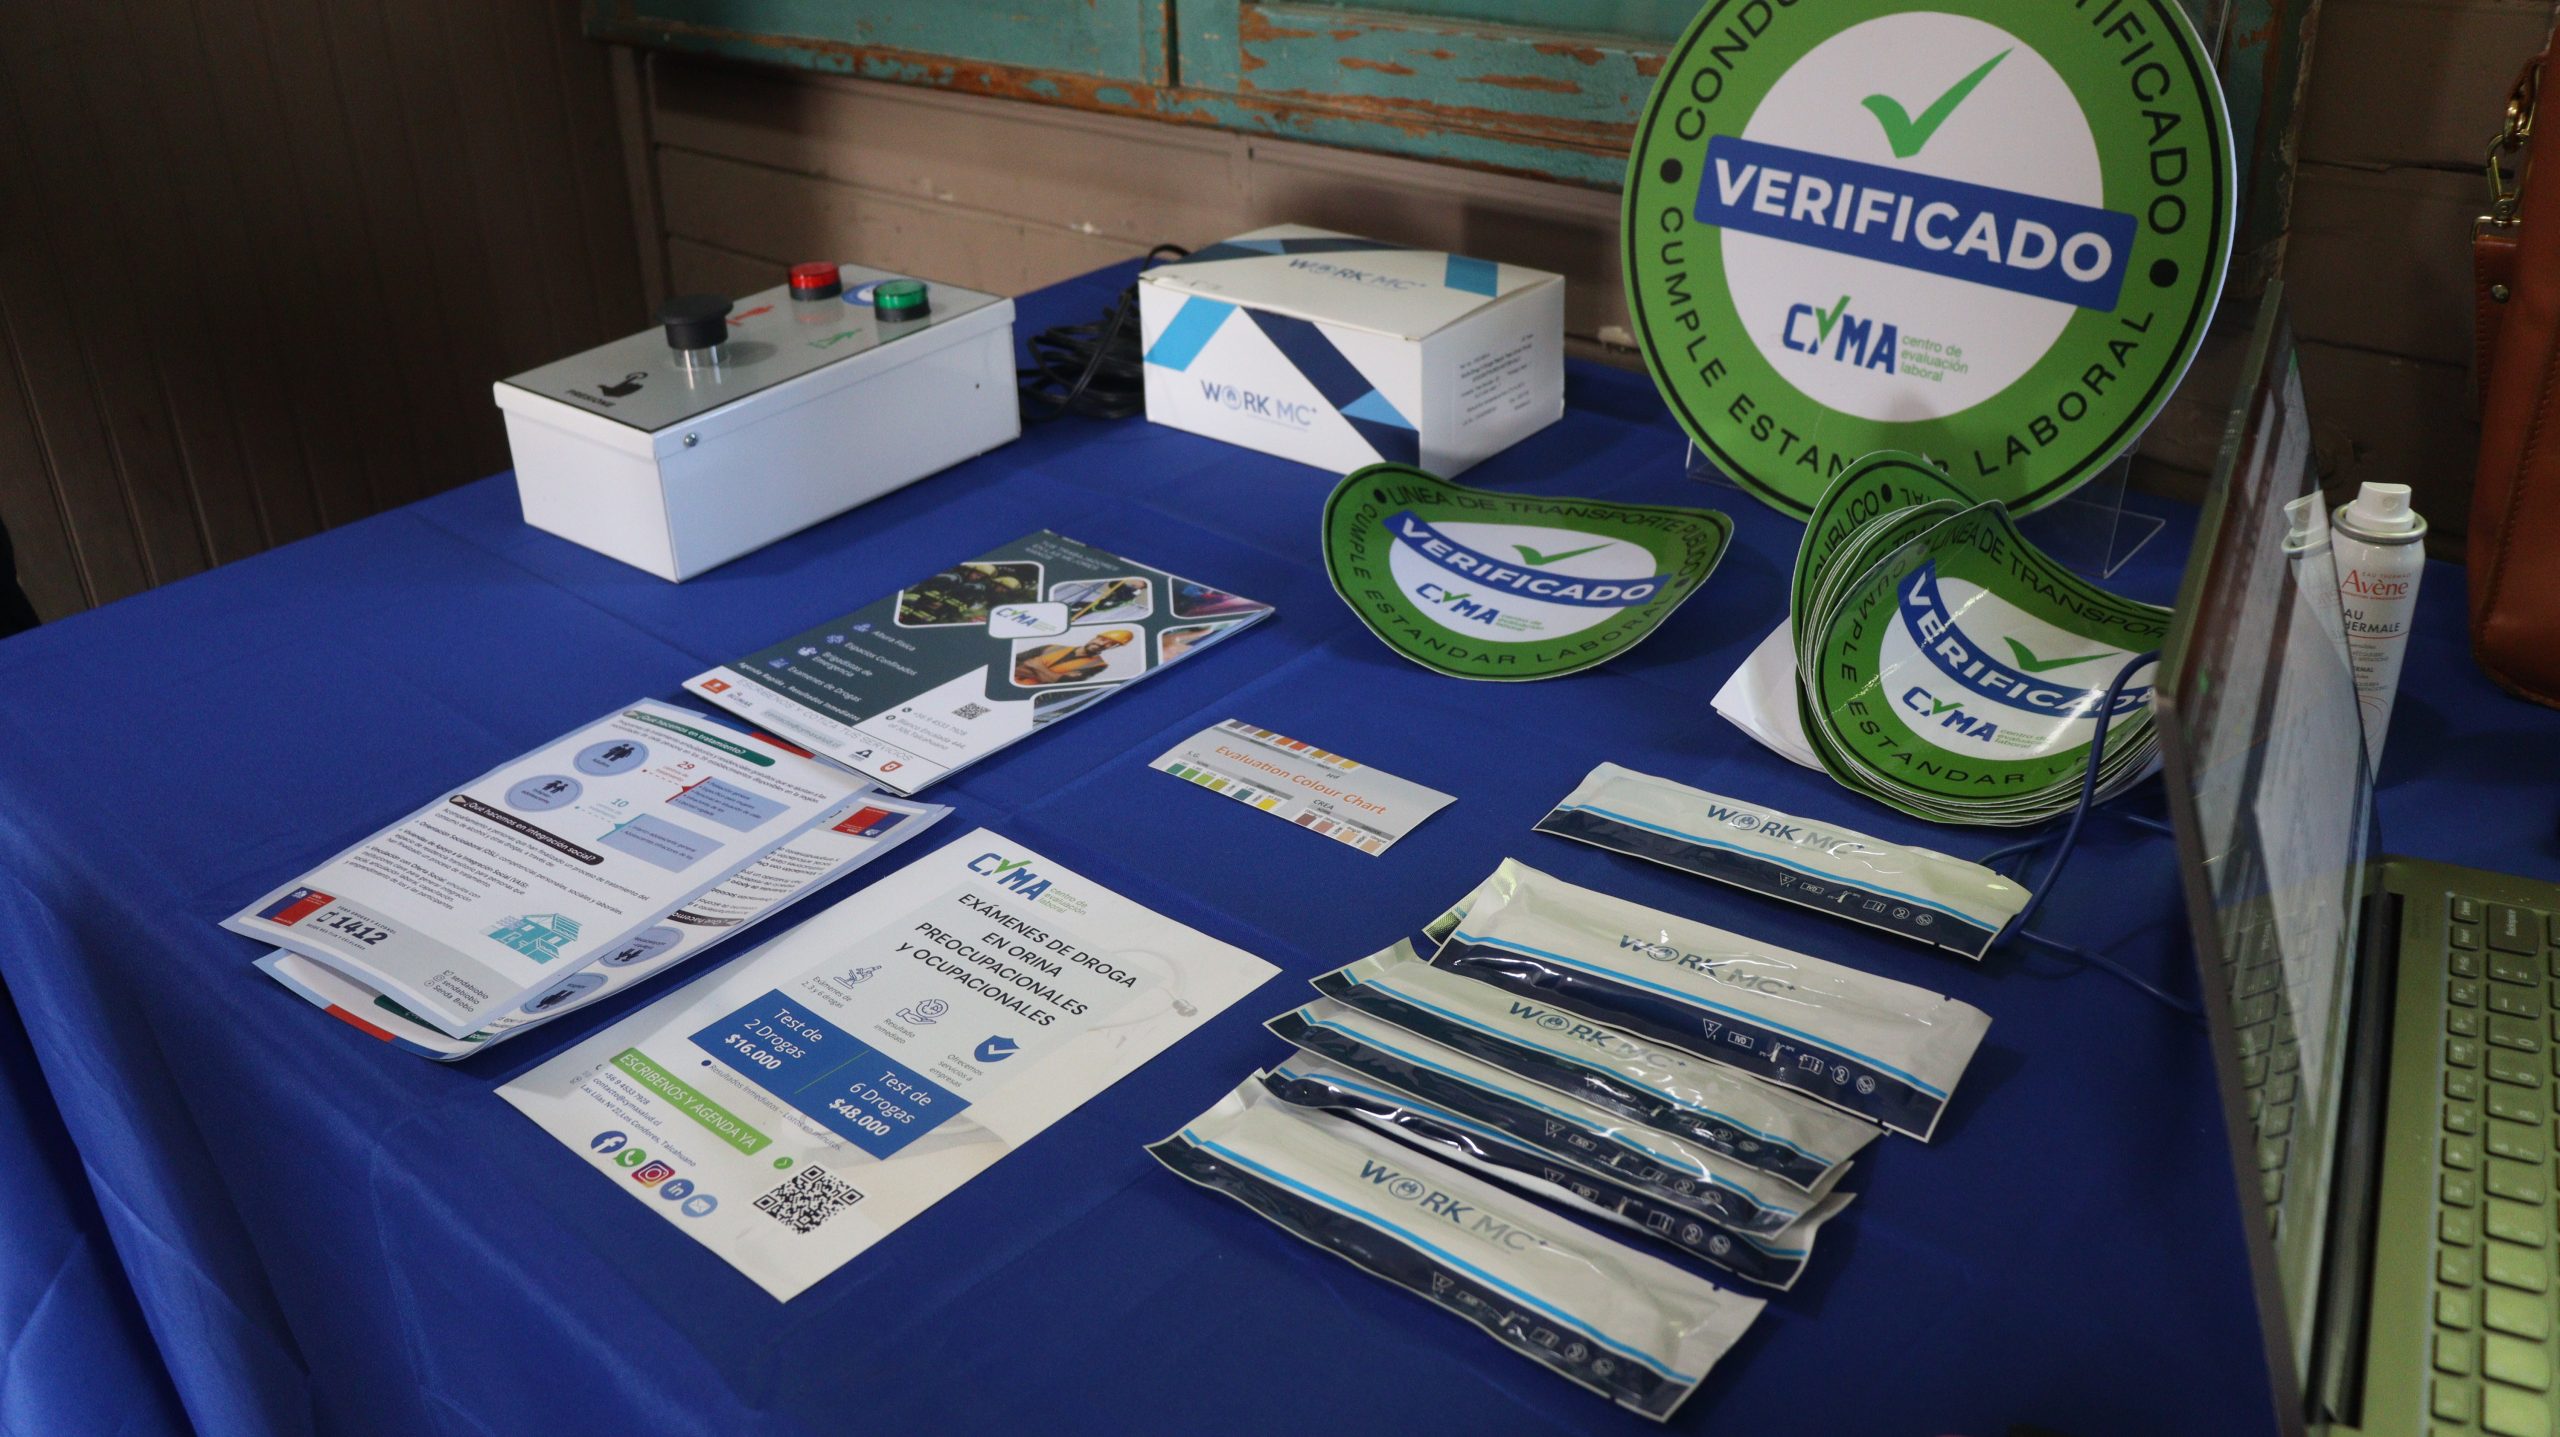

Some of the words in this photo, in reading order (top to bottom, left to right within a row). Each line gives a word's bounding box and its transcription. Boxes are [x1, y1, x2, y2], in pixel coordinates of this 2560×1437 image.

[1675, 0, 1800, 141] COND
[2075, 0, 2189, 234] IFICADO
[1714, 158, 2113, 283] VERIFICADO
[1660, 206, 1727, 388] CUMPLE
[1974, 310, 2154, 479] LABORAL
[1782, 295, 1897, 375] CYMA
[1901, 335, 1942, 353] centro
[1945, 343, 1962, 358] de
[1900, 348, 1968, 375] evaluación
[1900, 362, 1943, 383] laboral
[1200, 379, 1271, 416] WORK
[1387, 486, 1454, 508] LINEA
[1456, 495, 1498, 511] DE
[1508, 501, 1681, 534] TRANSPORTE
[1401, 517, 1655, 601] VERIFICADO
[1350, 502, 1378, 581] CUMPLE
[1365, 588, 1516, 665] ESTANDAR
[1978, 526, 2006, 565] DE
[2008, 554, 2168, 640] TRANSPOR
[2341, 569, 2409, 596] Avène
[1415, 582, 1500, 626] CYMA
[1841, 558, 1908, 683] CUMPLE
[2344, 608, 2364, 620] AU
[2344, 621, 2400, 633] HERMALE
[1902, 686, 1998, 743] CYMA
[695, 735, 747, 753] tratamiento?
[1849, 701, 2025, 785] ESTANDAR
[676, 761, 696, 770] 29
[1215, 746, 1292, 777] Evaluation
[1291, 775, 1344, 797] Colour
[1342, 793, 1388, 814] Chart
[609, 798, 630, 807] 10
[1312, 799, 1335, 809] CREA
[463, 801, 487, 811] ¿Qué
[483, 809, 517, 824] hacemos
[523, 827, 569, 848] integración
[566, 847, 596, 861] social?
[1706, 802, 1803, 842] WORK
[964, 851, 1053, 901] CYMA
[1049, 888, 1075, 900] centro
[1073, 899, 1089, 907] de
[327, 916, 390, 944] 1412
[672, 911, 707, 923] hacemo
[956, 893, 1050, 943] EXÁMENES
[1045, 940, 1074, 955] DE
[1070, 952, 1139, 986] DROGA
[981, 932, 1011, 948] EN
[1005, 946, 1065, 976] ORINA
[1619, 934, 1730, 978] WORK
[451, 976, 490, 998] sendabiobio
[894, 942, 913, 953] y
[910, 949, 1057, 1026] OCUPACIONALES
[914, 923, 1088, 1014] PREOCUPACIONALES
[432, 985, 454, 998] Senda
[442, 980, 481, 1003] sendabiobio
[821, 994, 846, 1008] drogas
[743, 1018, 761, 1029] 2
[771, 1009, 807, 1030] Test
[800, 1026, 826, 1042] de
[883, 1018, 916, 1037] Resultado
[1508, 1000, 1616, 1051] WORK
[722, 1033, 783, 1070] $16.000
[751, 1026, 808, 1060] Drogas
[708, 1065, 745, 1087] Resultados
[946, 1054, 984, 1075] Ofrecemos
[618, 1083, 636, 1095] 4533
[633, 1093, 651, 1105] 7928
[619, 1054, 688, 1099] ESCRIBENOS
[681, 1096, 697, 1106] Y
[691, 1103, 742, 1136] AGENDA
[735, 1133, 758, 1147] YA
[847, 1081, 866, 1093] 6
[876, 1071, 915, 1094] Test
[908, 1089, 936, 1106] de
[827, 1097, 891, 1137] $48.000
[856, 1089, 917, 1126] Drogas
[1359, 1159, 1471, 1227] WORK
